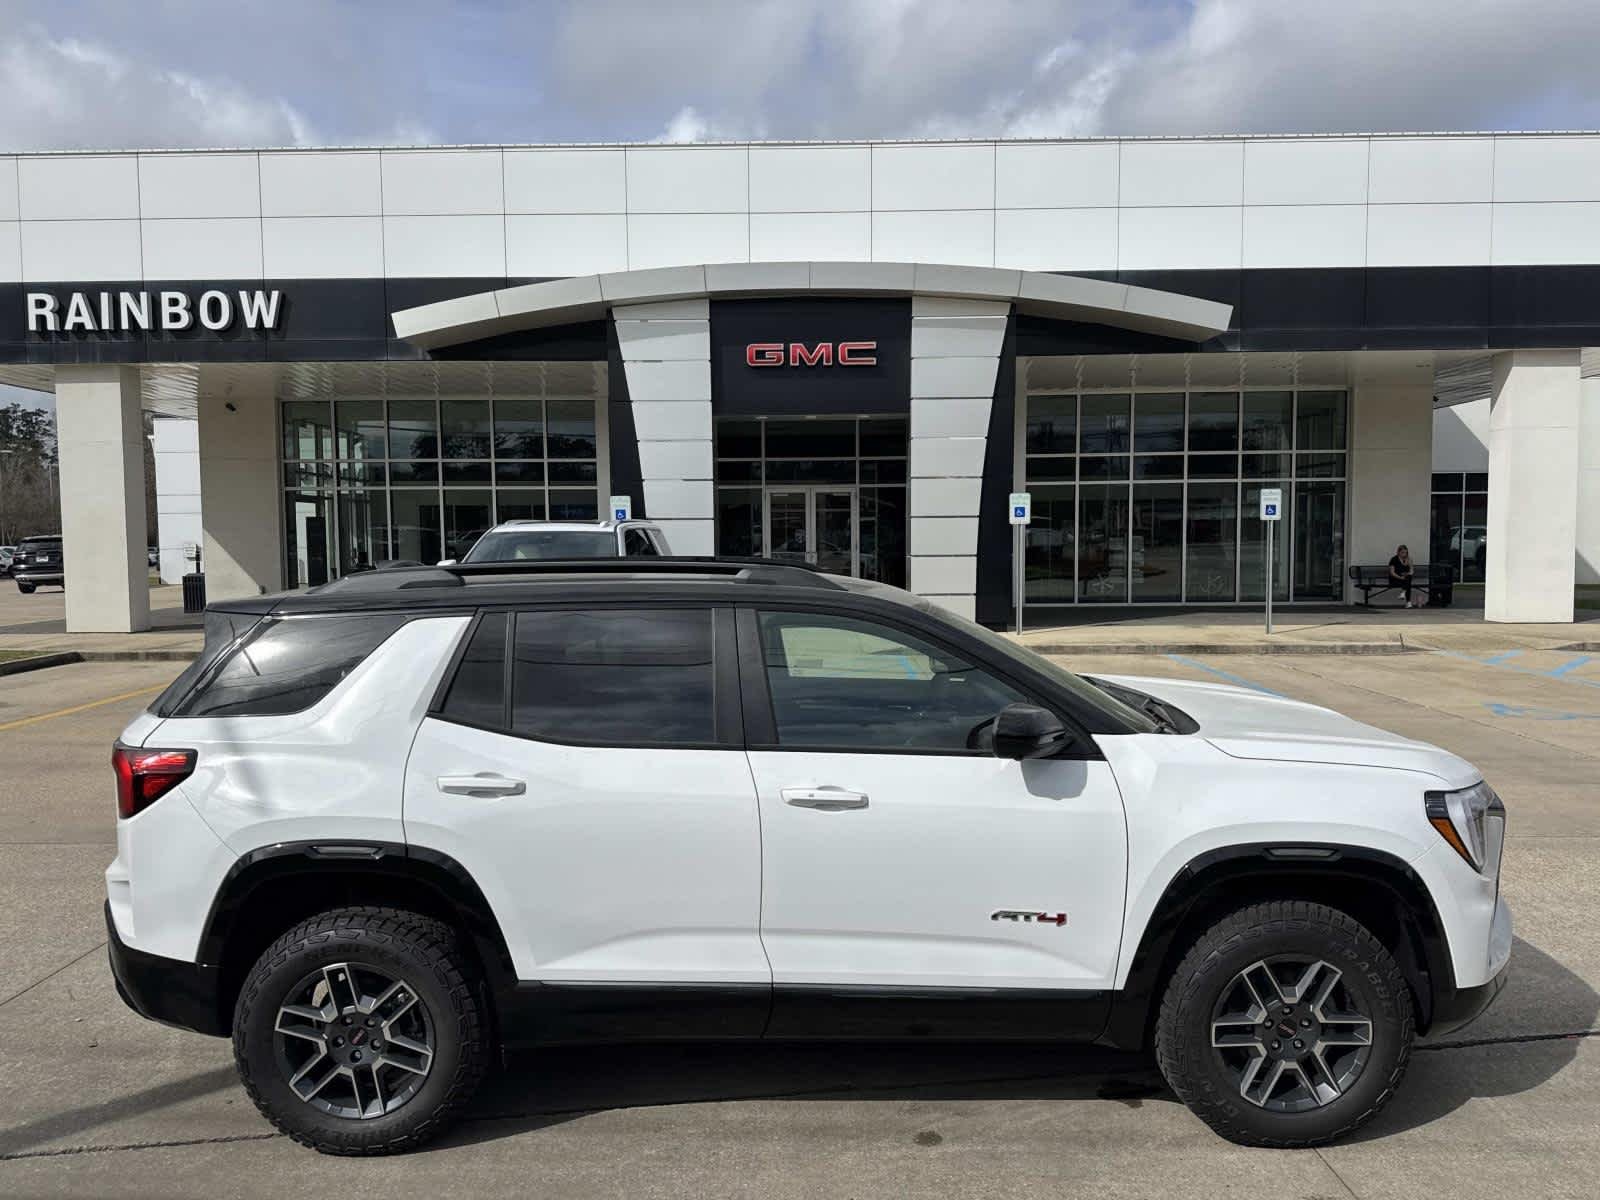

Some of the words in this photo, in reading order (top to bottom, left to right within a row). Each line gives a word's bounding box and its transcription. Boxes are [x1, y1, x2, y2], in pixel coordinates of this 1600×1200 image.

[27, 289, 280, 332] RAINBOW
[746, 341, 877, 367] GMC
[990, 910, 1067, 928] AT4
